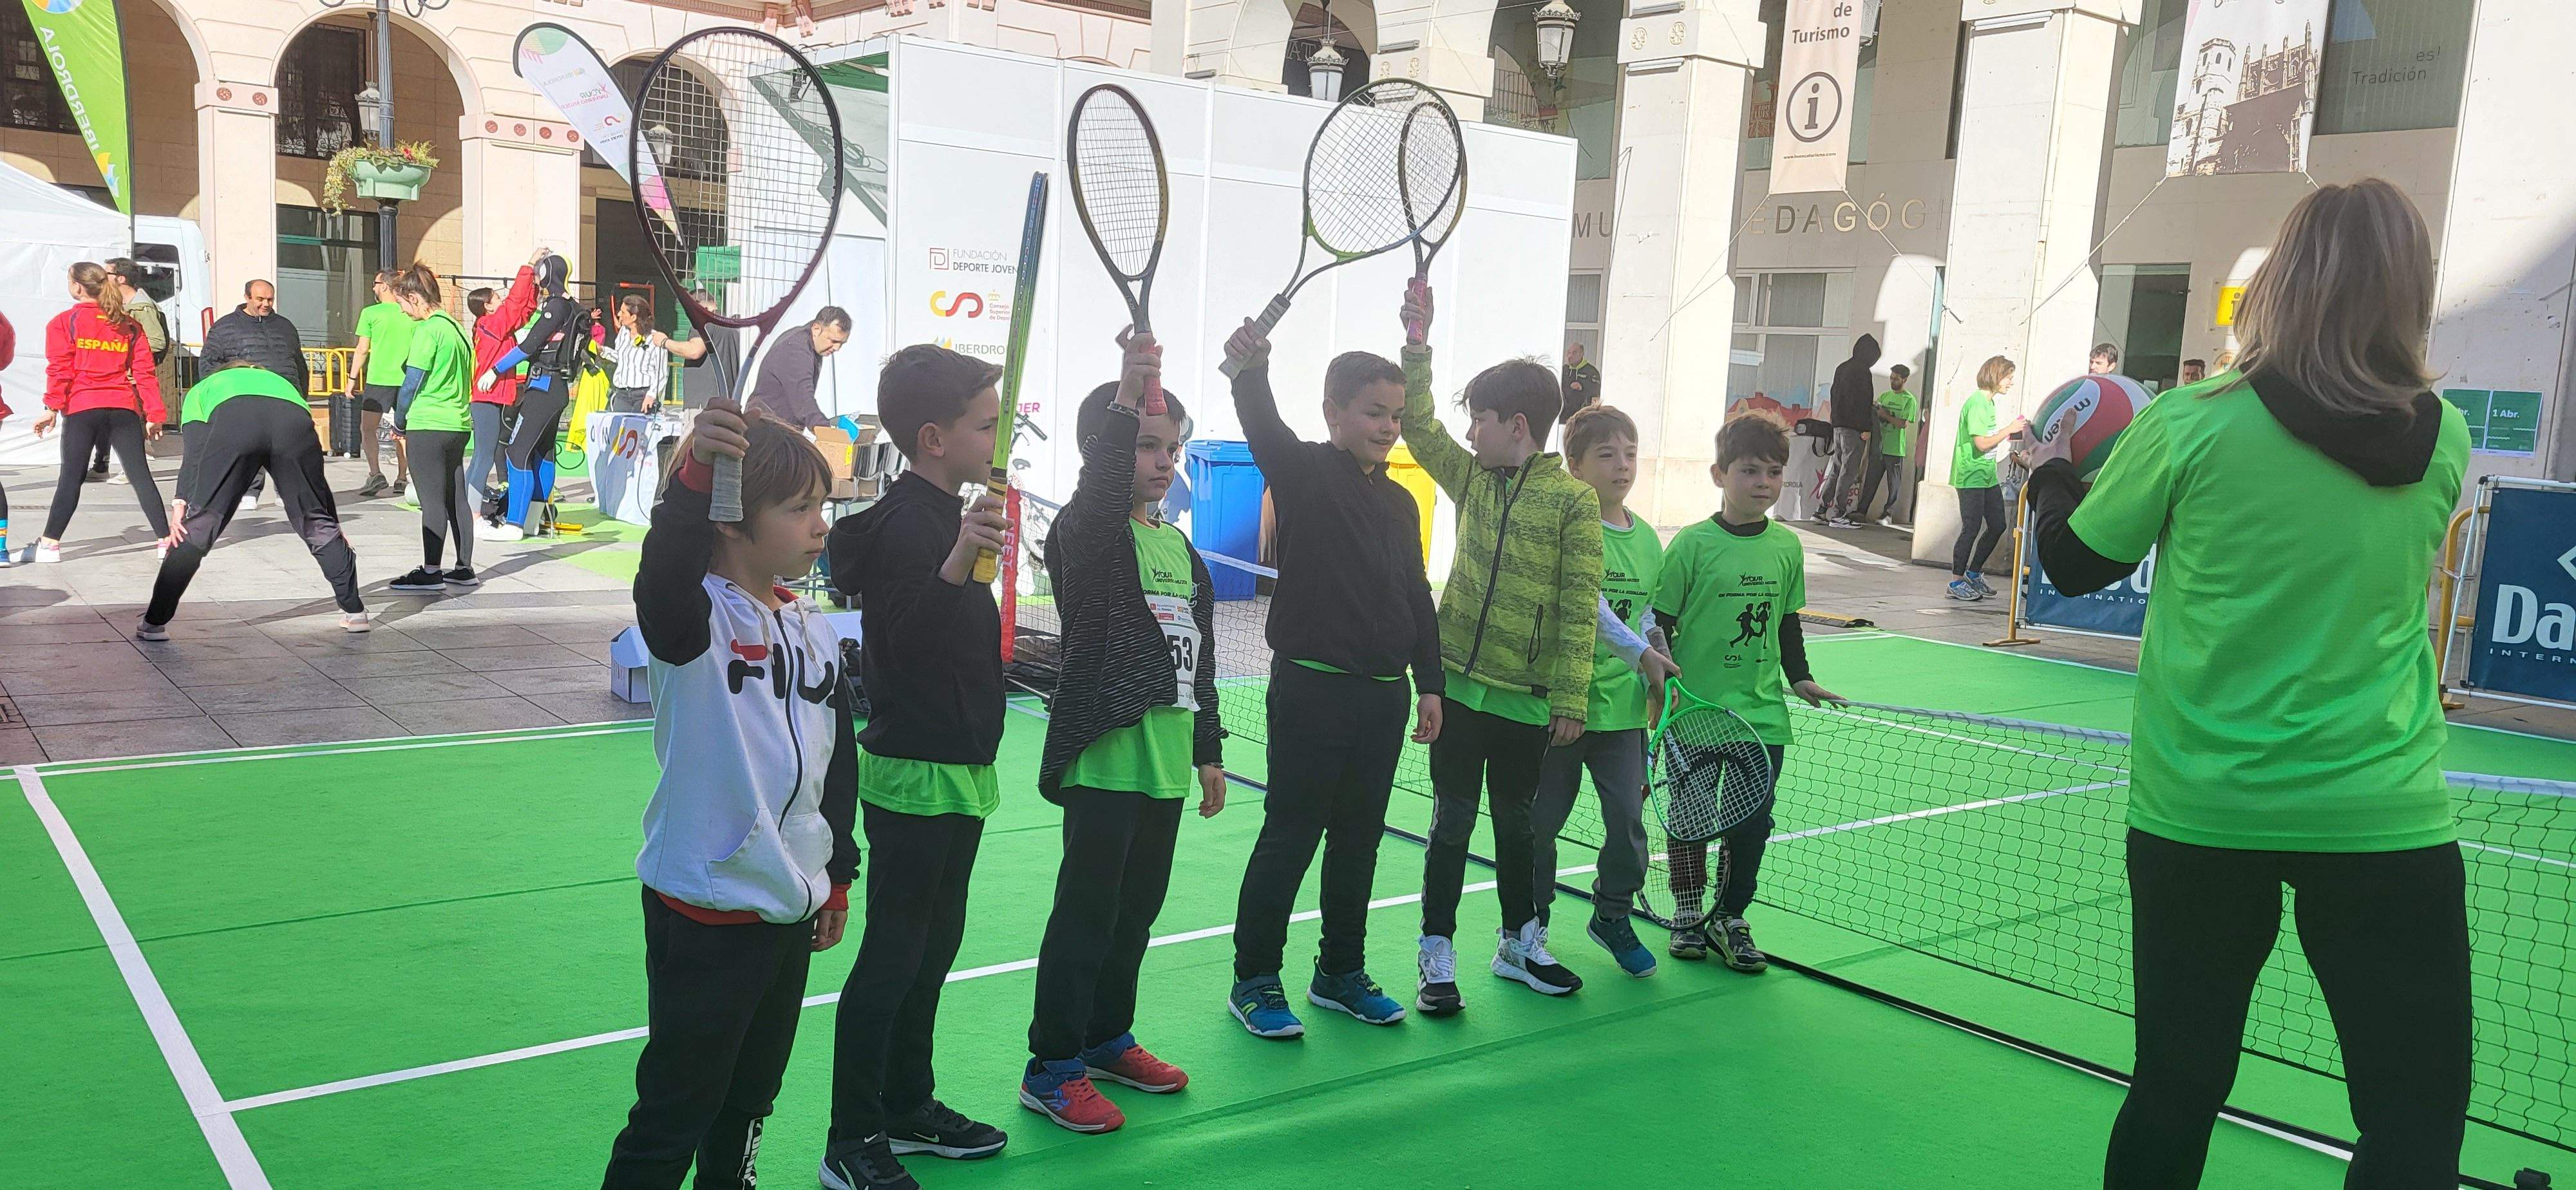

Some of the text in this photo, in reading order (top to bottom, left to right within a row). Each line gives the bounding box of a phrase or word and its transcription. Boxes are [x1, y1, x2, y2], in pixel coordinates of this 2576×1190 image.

[1833, 2, 1852, 17] de
[1792, 26, 1850, 44] Turismo
[2353, 66, 2426, 85] Tradición
[1748, 193, 1945, 234] EDAGÓGI
[953, 249, 1007, 261] FUNDACIÓN
[953, 262, 989, 272] DEPORTE
[77, 338, 129, 352] ESPAÑA
[956, 344, 1005, 354] IBERDRO
[2492, 409, 2519, 419] 1 Abr.
[2040, 589, 2146, 605] INRNATIO
